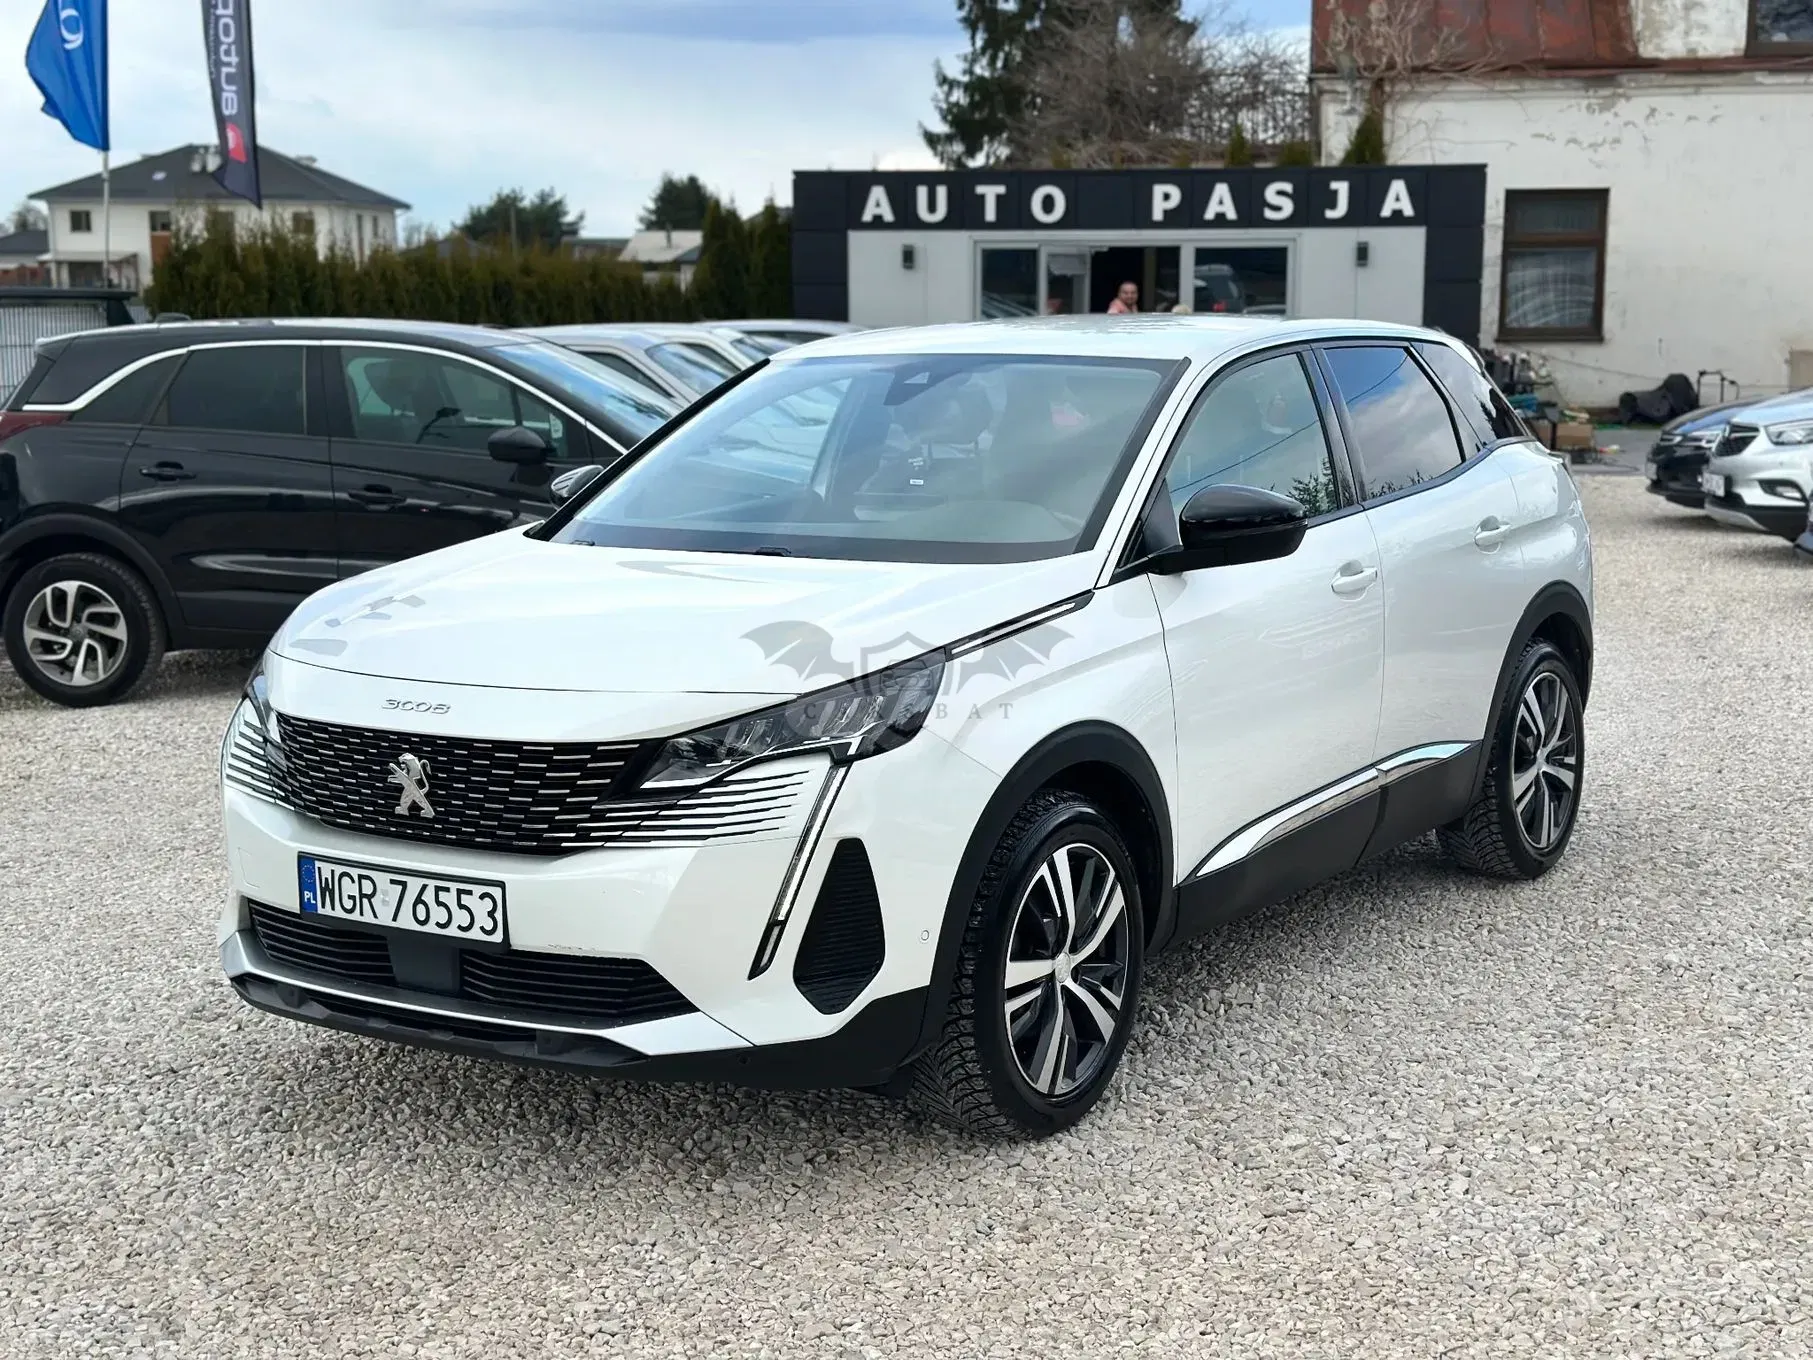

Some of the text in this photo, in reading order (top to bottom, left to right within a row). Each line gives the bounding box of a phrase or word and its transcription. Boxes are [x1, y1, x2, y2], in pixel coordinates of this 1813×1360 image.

[861, 179, 1415, 223] AUTO PASJA
[304, 891, 316, 904] PL
[317, 866, 498, 936] WGR 76553
